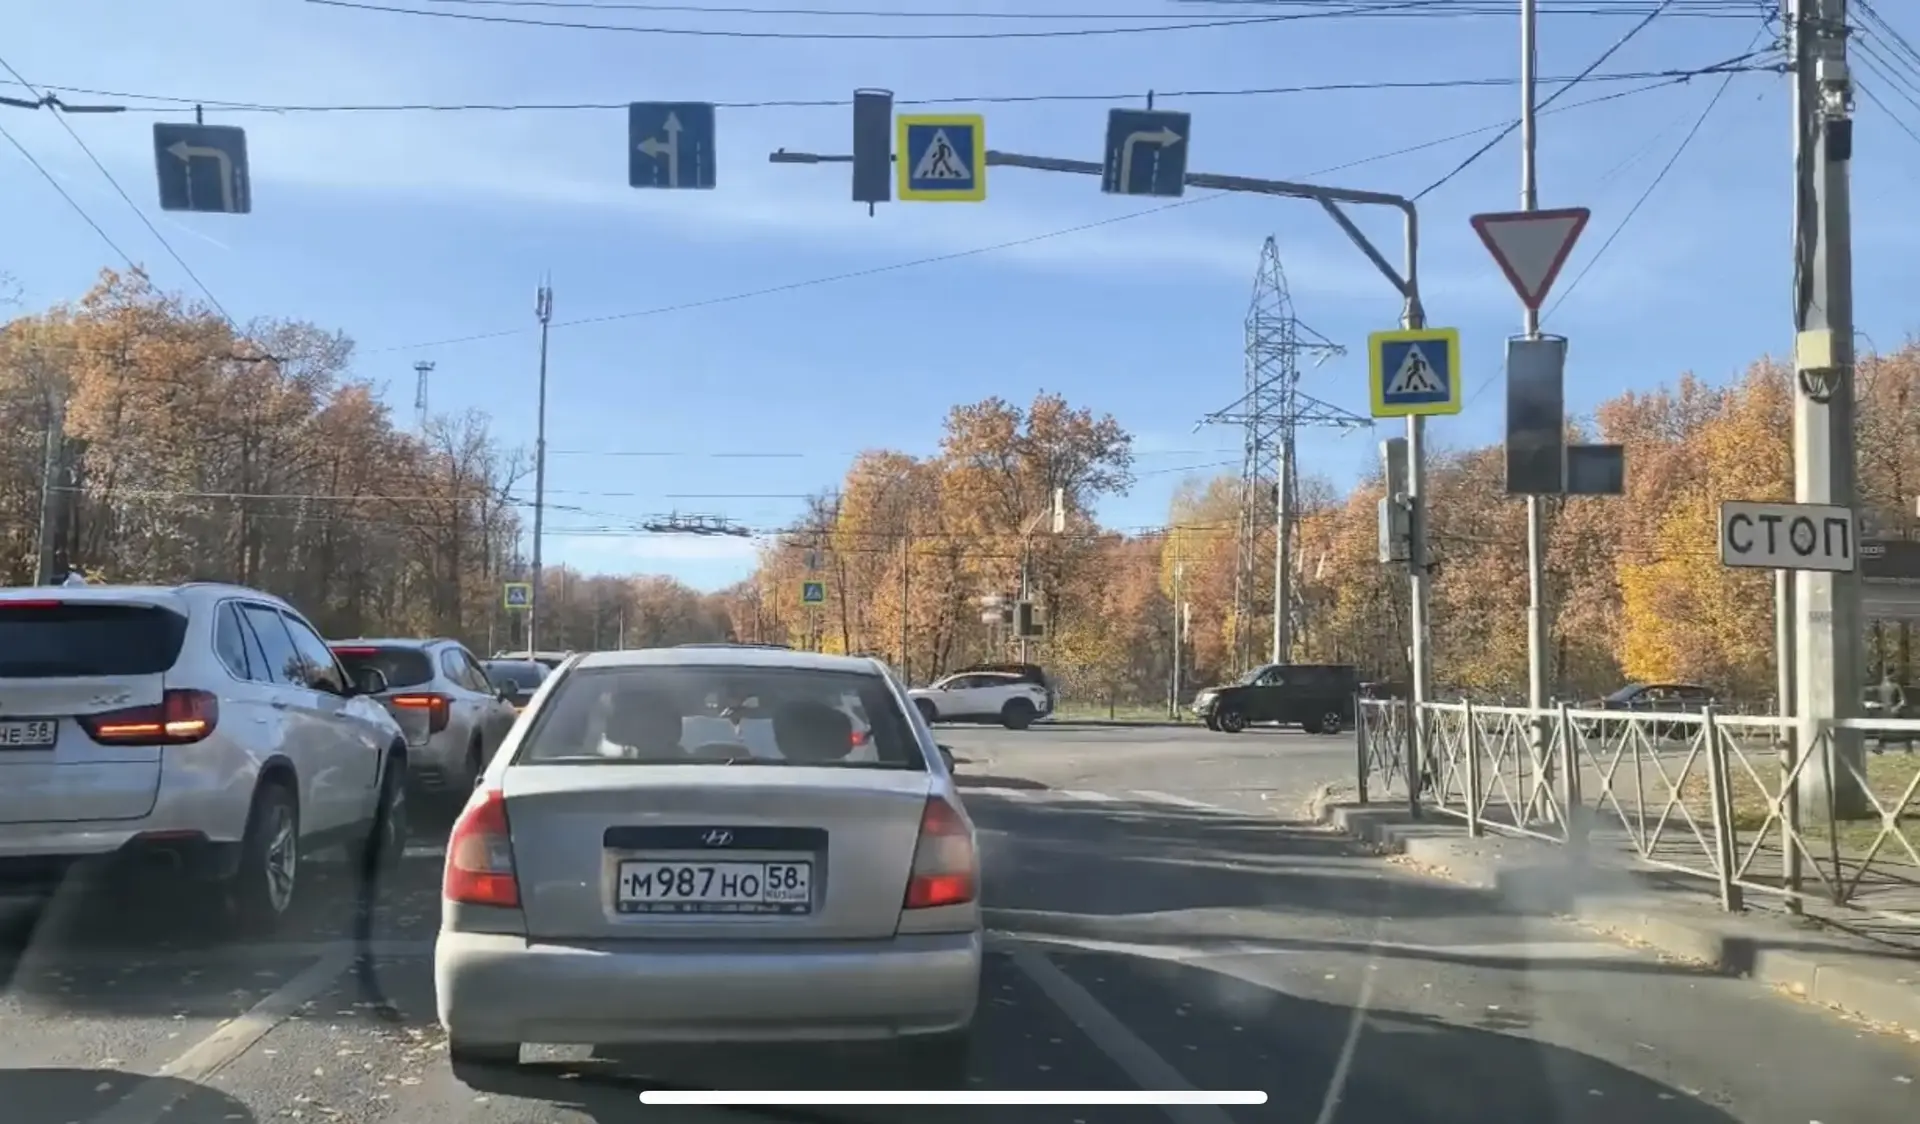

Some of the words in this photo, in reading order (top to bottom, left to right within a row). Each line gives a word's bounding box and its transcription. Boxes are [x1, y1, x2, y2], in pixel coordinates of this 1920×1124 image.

[1728, 513, 1849, 558] СТОП
[631, 866, 760, 898] М987НО
[769, 866, 798, 890] 58
